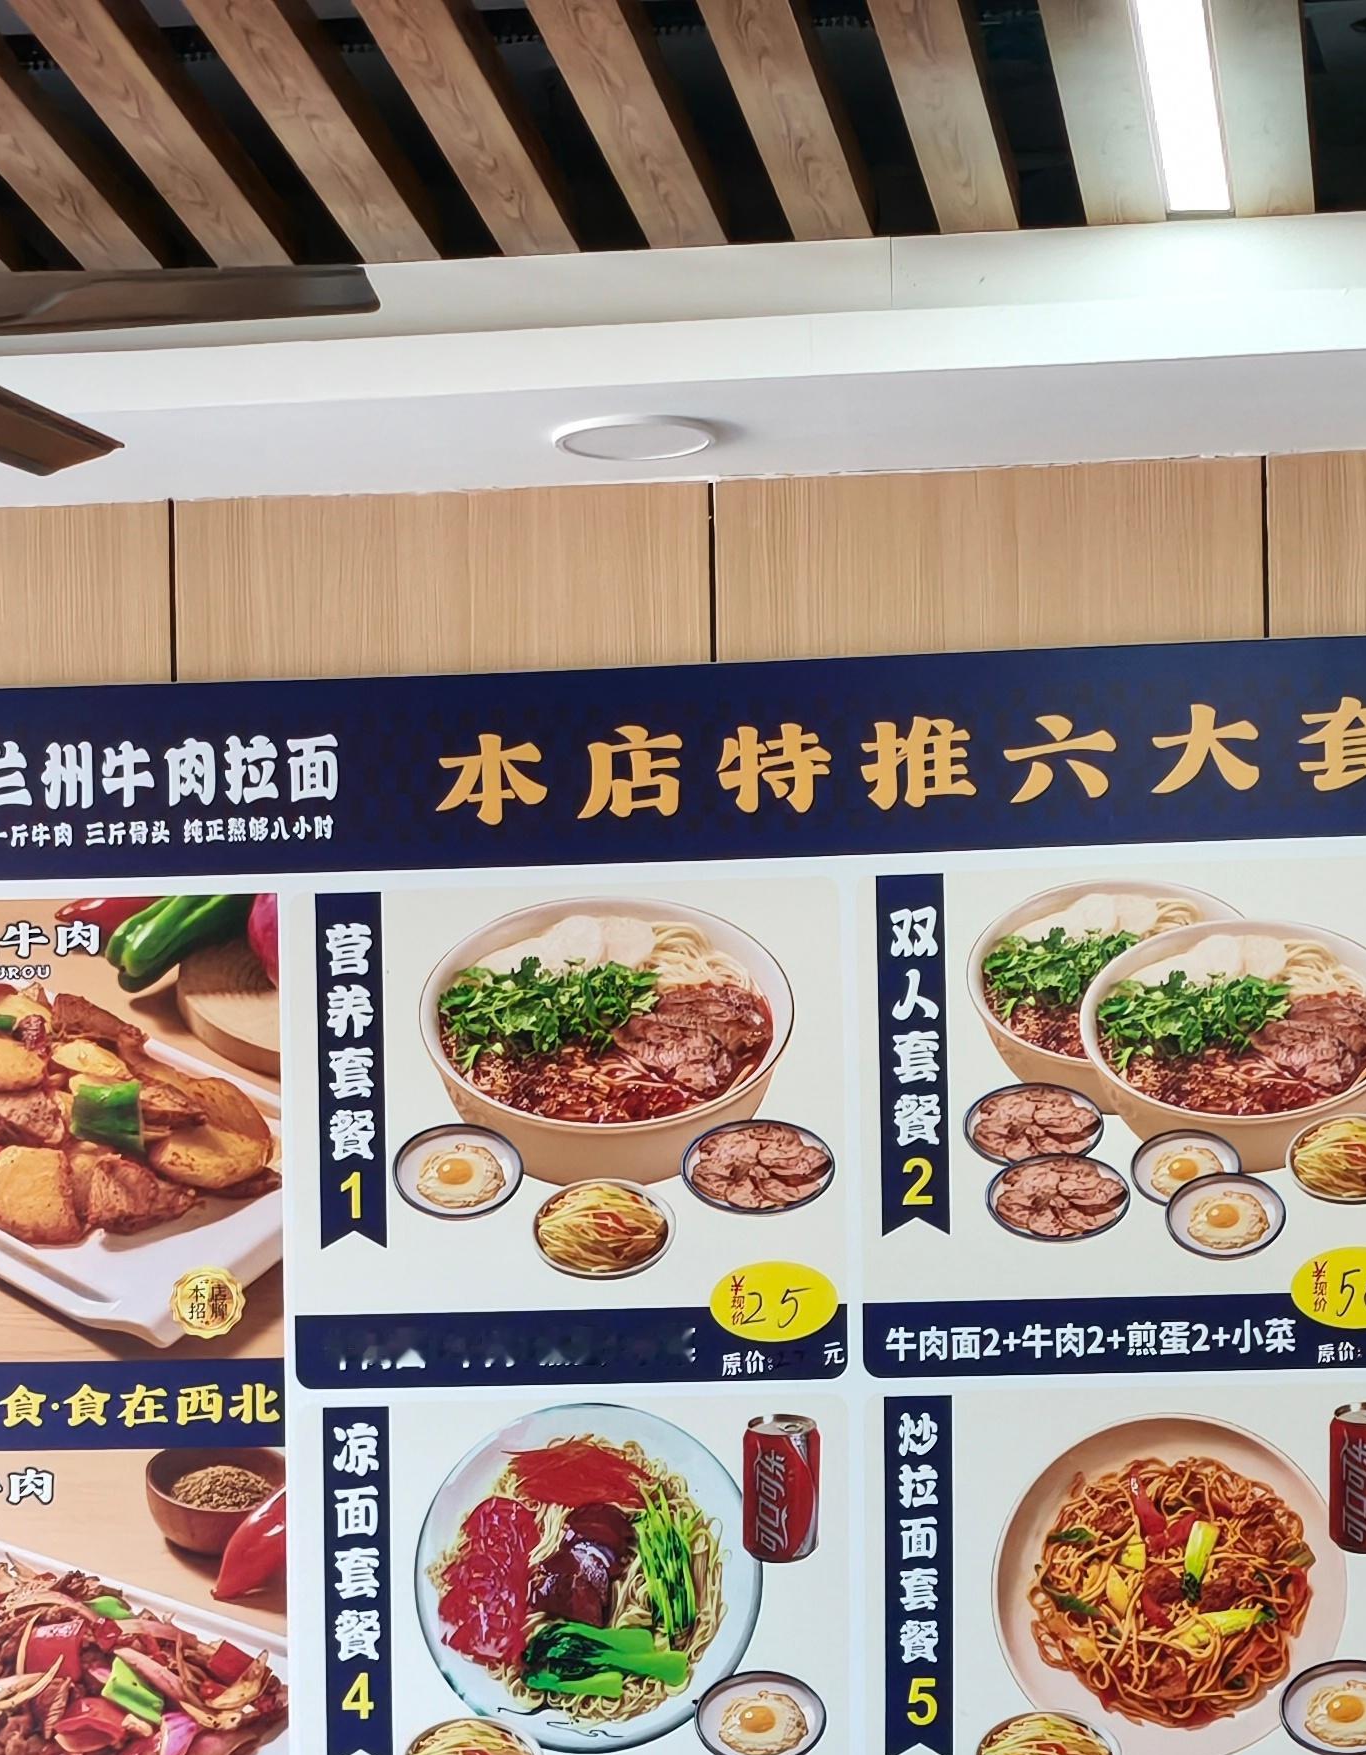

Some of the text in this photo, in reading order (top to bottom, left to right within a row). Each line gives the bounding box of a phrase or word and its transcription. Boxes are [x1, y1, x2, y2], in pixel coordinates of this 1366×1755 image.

[85, 821, 170, 846] 三斤骨头
[744, 1286, 813, 1330] 25
[824, 1342, 844, 1365] 元
[885, 1318, 1297, 1361] 牛肉面2+牛肉2+煎蛋2+小菜
